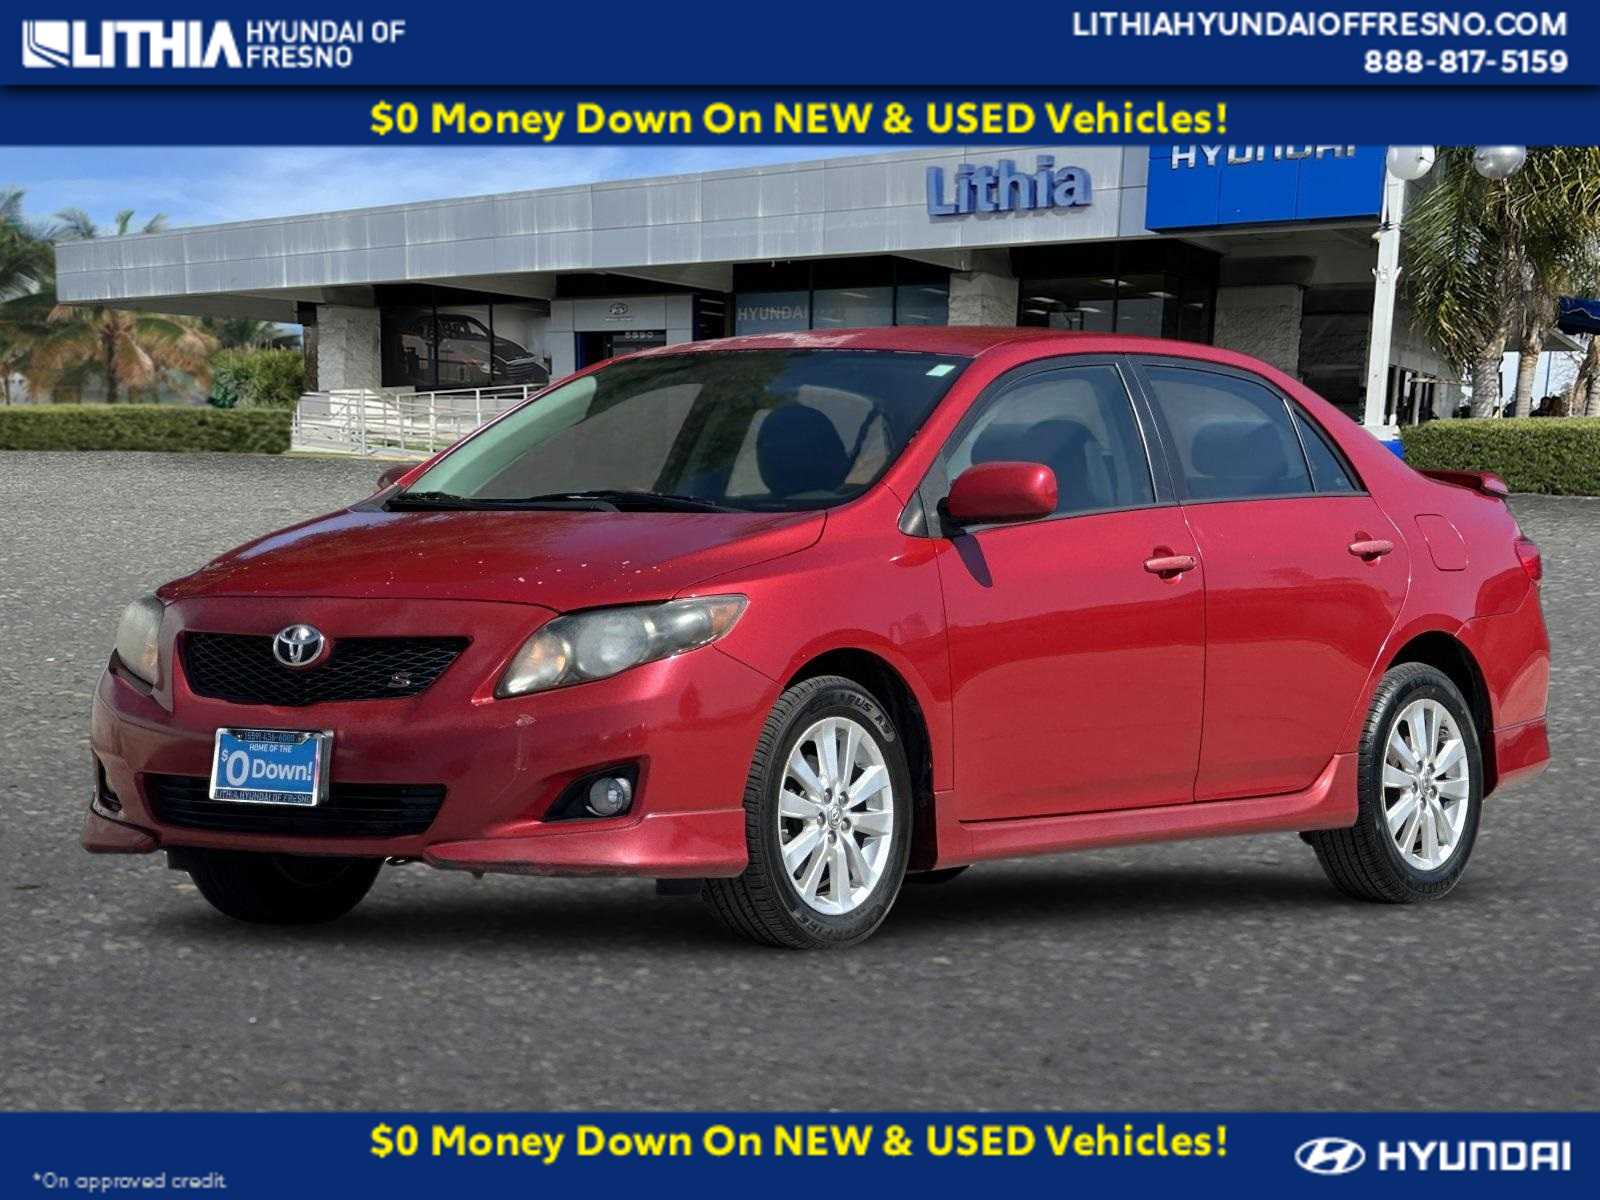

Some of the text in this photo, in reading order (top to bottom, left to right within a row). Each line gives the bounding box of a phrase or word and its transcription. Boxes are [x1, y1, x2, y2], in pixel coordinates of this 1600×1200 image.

[926, 155, 1092, 216] Lithia
[737, 305, 808, 321] HYUNDAI
[249, 743, 293, 753] HOME OF THE
[251, 758, 313, 781] Down!
[240, 790, 271, 801] HYUNDAI
